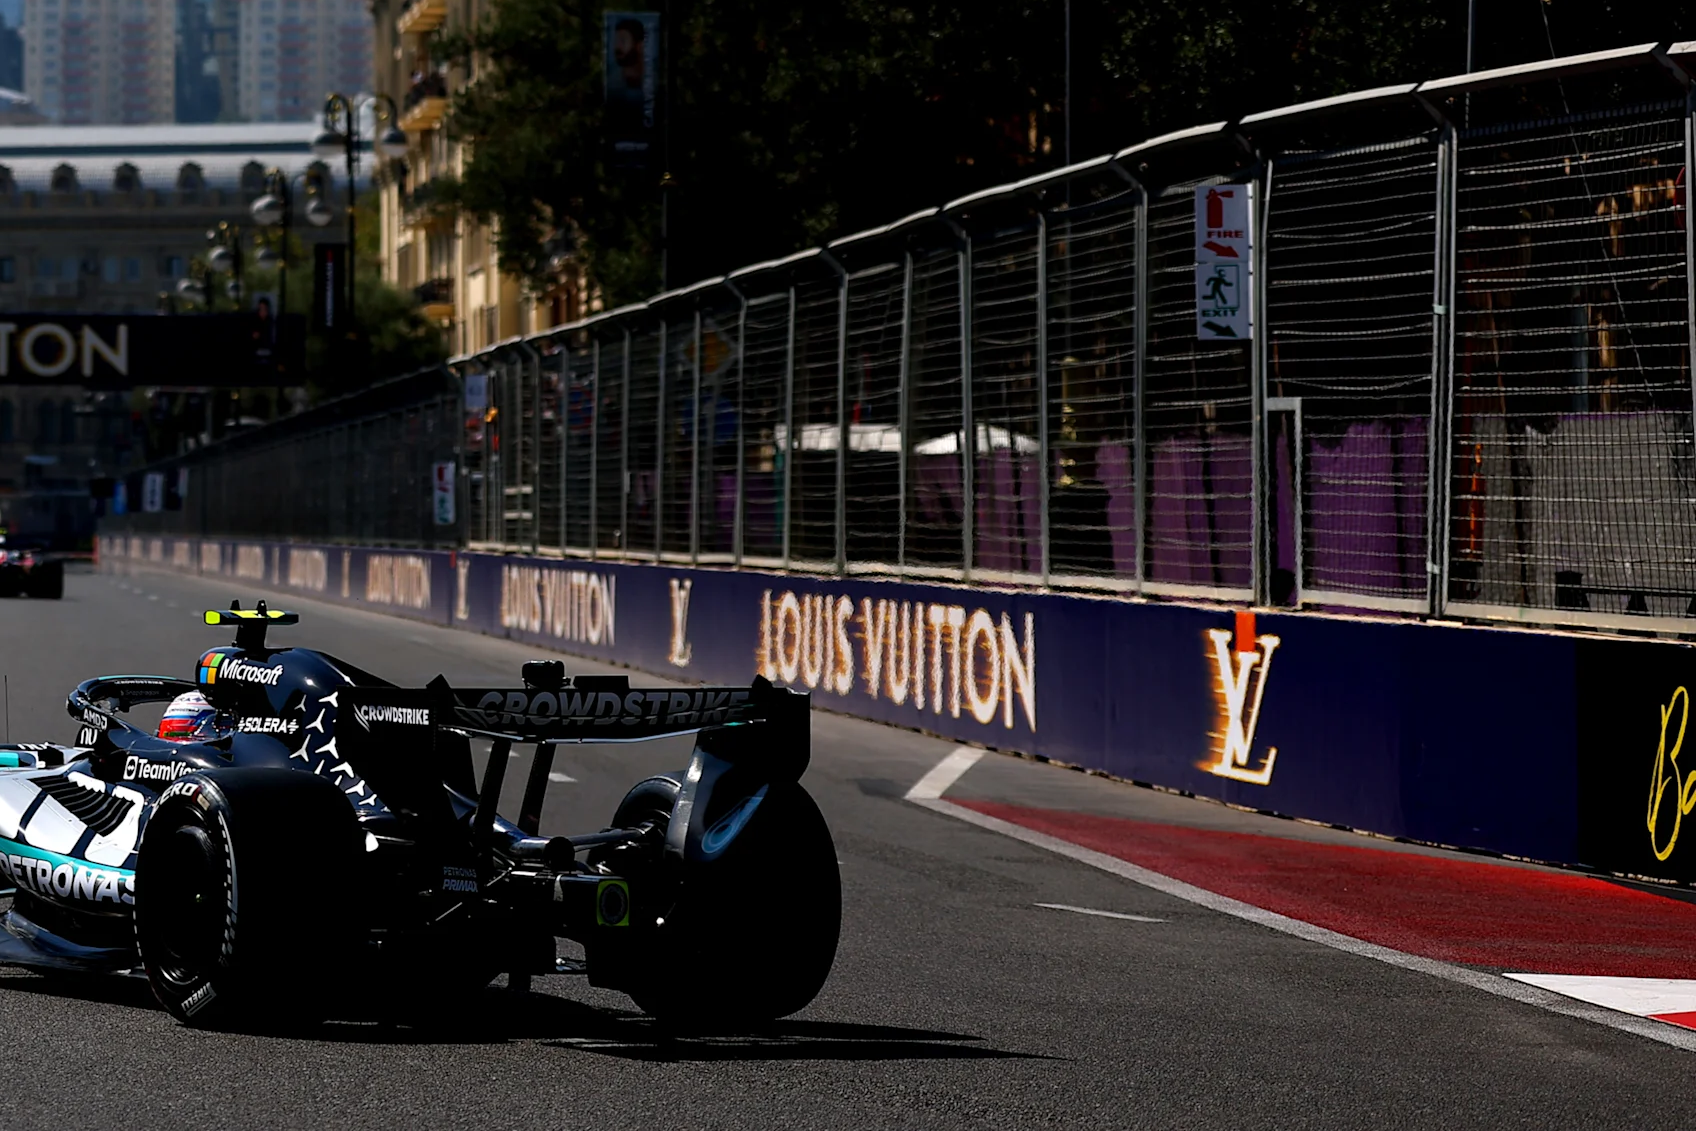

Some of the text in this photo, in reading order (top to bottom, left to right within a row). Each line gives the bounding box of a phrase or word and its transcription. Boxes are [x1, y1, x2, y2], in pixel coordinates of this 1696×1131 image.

[1207, 230, 1244, 238] FIRE
[1202, 309, 1239, 318] EXIT
[542, 566, 617, 647] VUITTON
[759, 588, 1036, 733] LOUIS VUITTON
[219, 657, 283, 686] Microsoft
[83, 708, 101, 726] AMD
[360, 705, 430, 726] CROWDSTRIKE
[476, 690, 752, 727] CROWDSTRIKE
[244, 717, 289, 734] SOLERA
[443, 866, 476, 878] PETRONAS
[443, 879, 478, 892] PRIMAX
